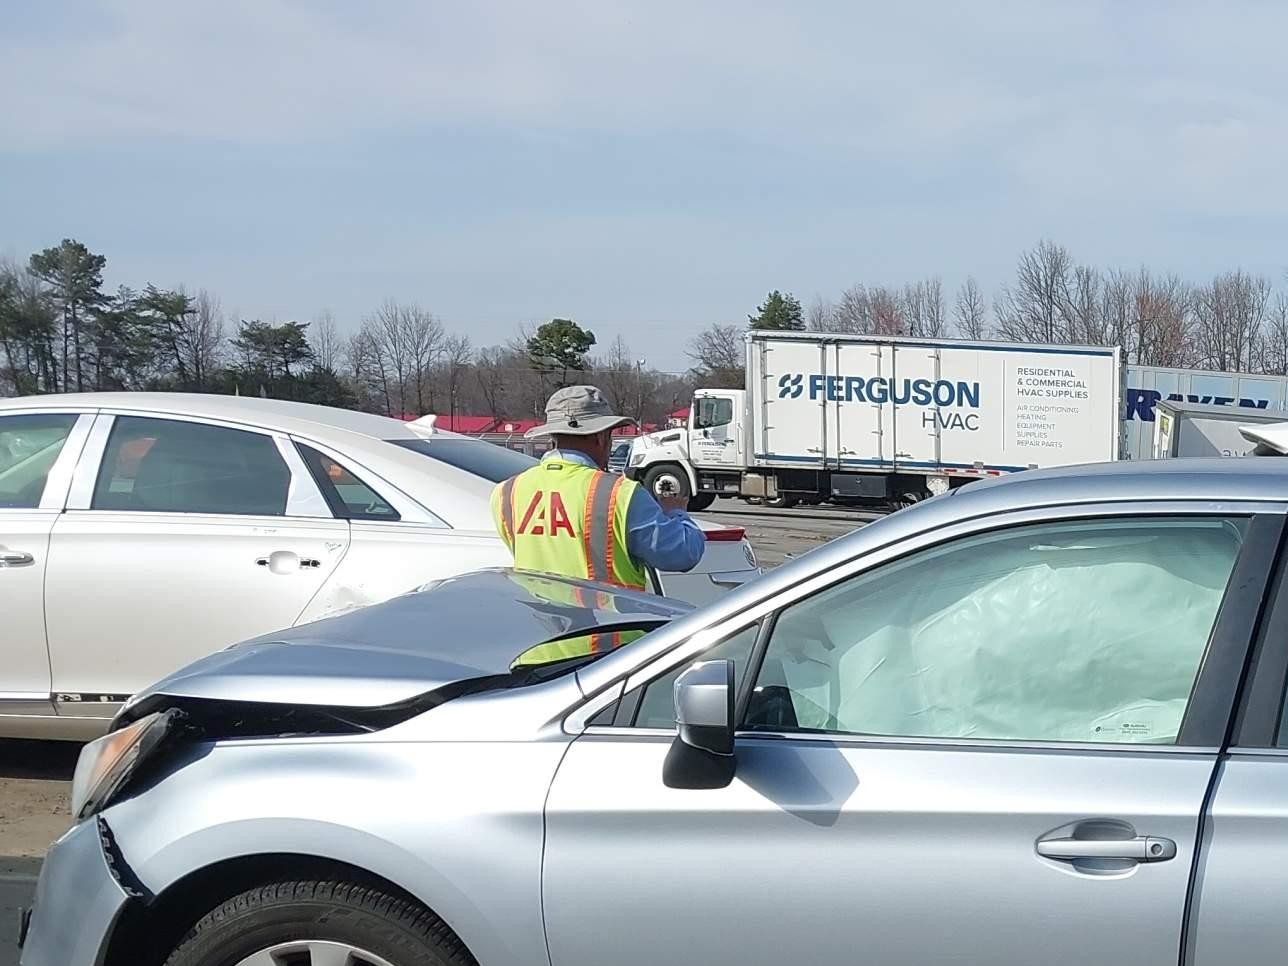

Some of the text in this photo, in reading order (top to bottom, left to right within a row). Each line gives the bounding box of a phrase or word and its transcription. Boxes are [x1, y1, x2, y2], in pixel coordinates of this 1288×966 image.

[1017, 368, 1076, 378] RESIDENTIAL
[1017, 378, 1087, 389] & COMMERCIAL
[809, 374, 980, 408] FERGUSON
[1017, 388, 1088, 399] HVAC SUPPLIES
[1029, 405, 1079, 414] CONDITIONING
[922, 411, 979, 431] HVAC
[1017, 422, 1056, 431] EQUIPMENT
[1017, 431, 1048, 439] SUPPLIES
[1041, 441, 1063, 449] PARTS
